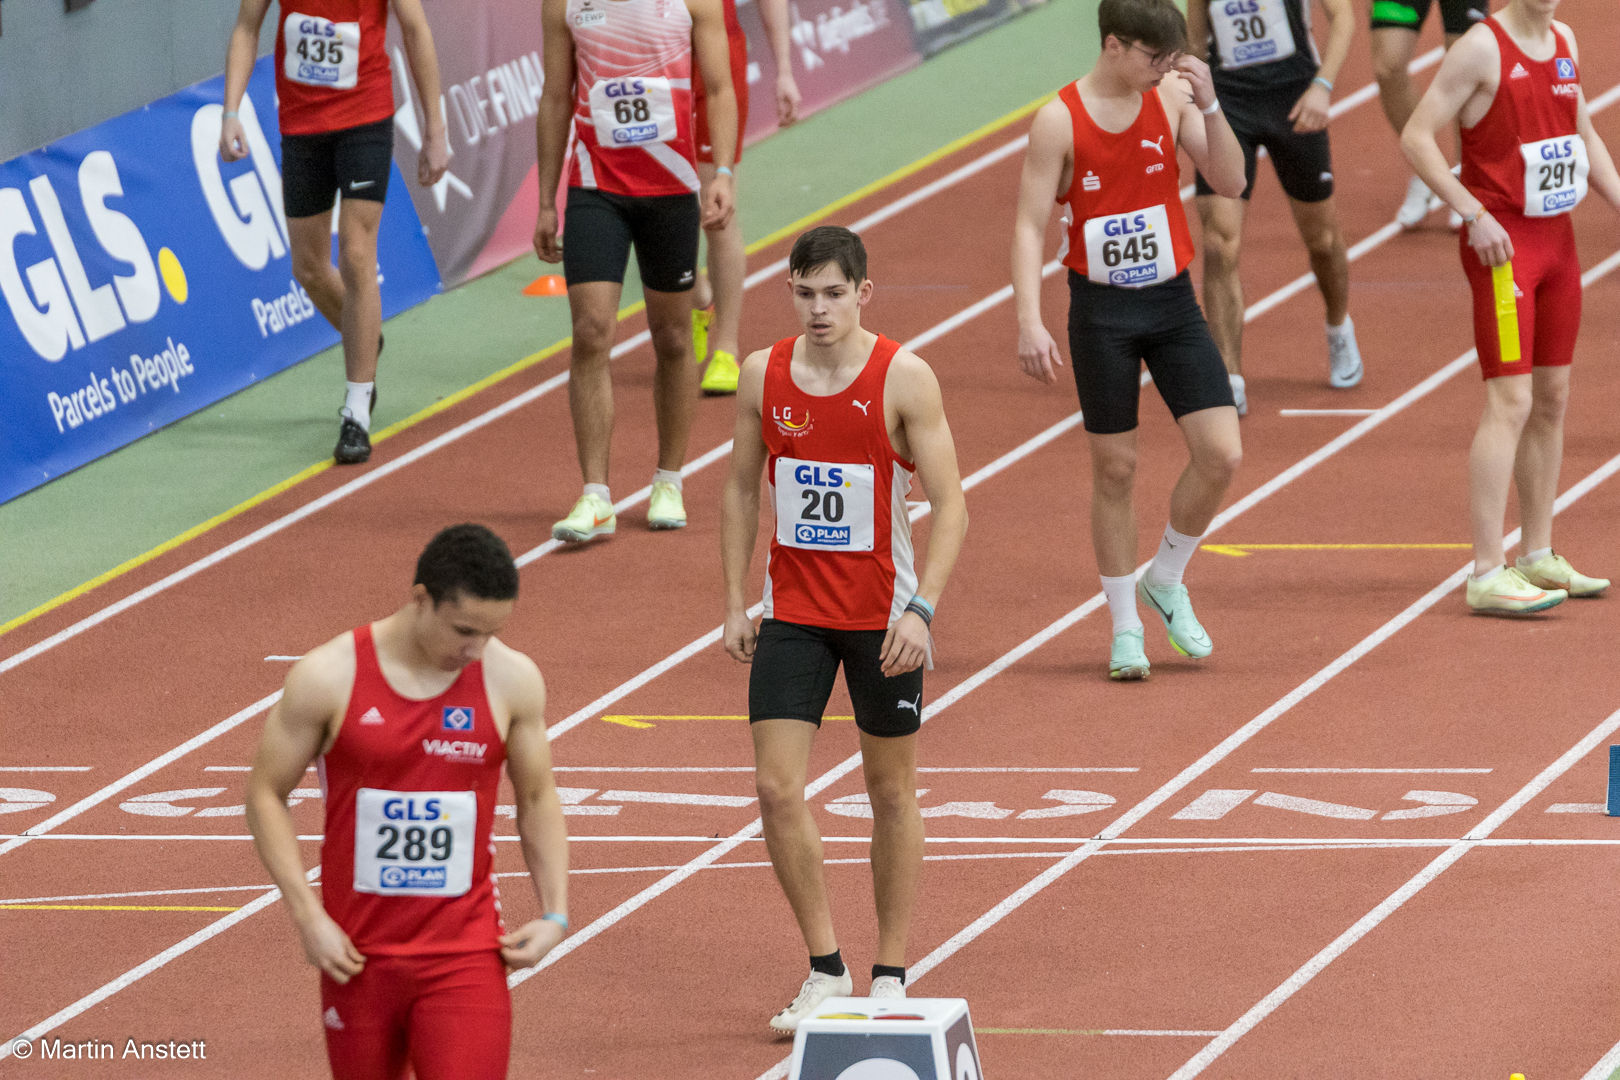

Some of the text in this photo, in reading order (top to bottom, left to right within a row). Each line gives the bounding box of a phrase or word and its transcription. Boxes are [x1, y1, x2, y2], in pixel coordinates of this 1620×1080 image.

[1233, 15, 1266, 42] 30
[297, 36, 343, 64] 435
[614, 98, 650, 124] 68
[630, 126, 656, 137] PLAN
[1539, 159, 1576, 191] 291
[1558, 190, 1576, 203] PLAN
[1102, 232, 1158, 267] 645
[1129, 266, 1155, 278] PLAN
[251, 279, 315, 338] Parcels
[47, 336, 194, 434] Parcels to People
[801, 489, 844, 522] 20
[817, 528, 848, 539] PLAN
[422, 739, 488, 757] VIACTIV
[376, 824, 454, 861] 289
[408, 869, 445, 881] PLAN
